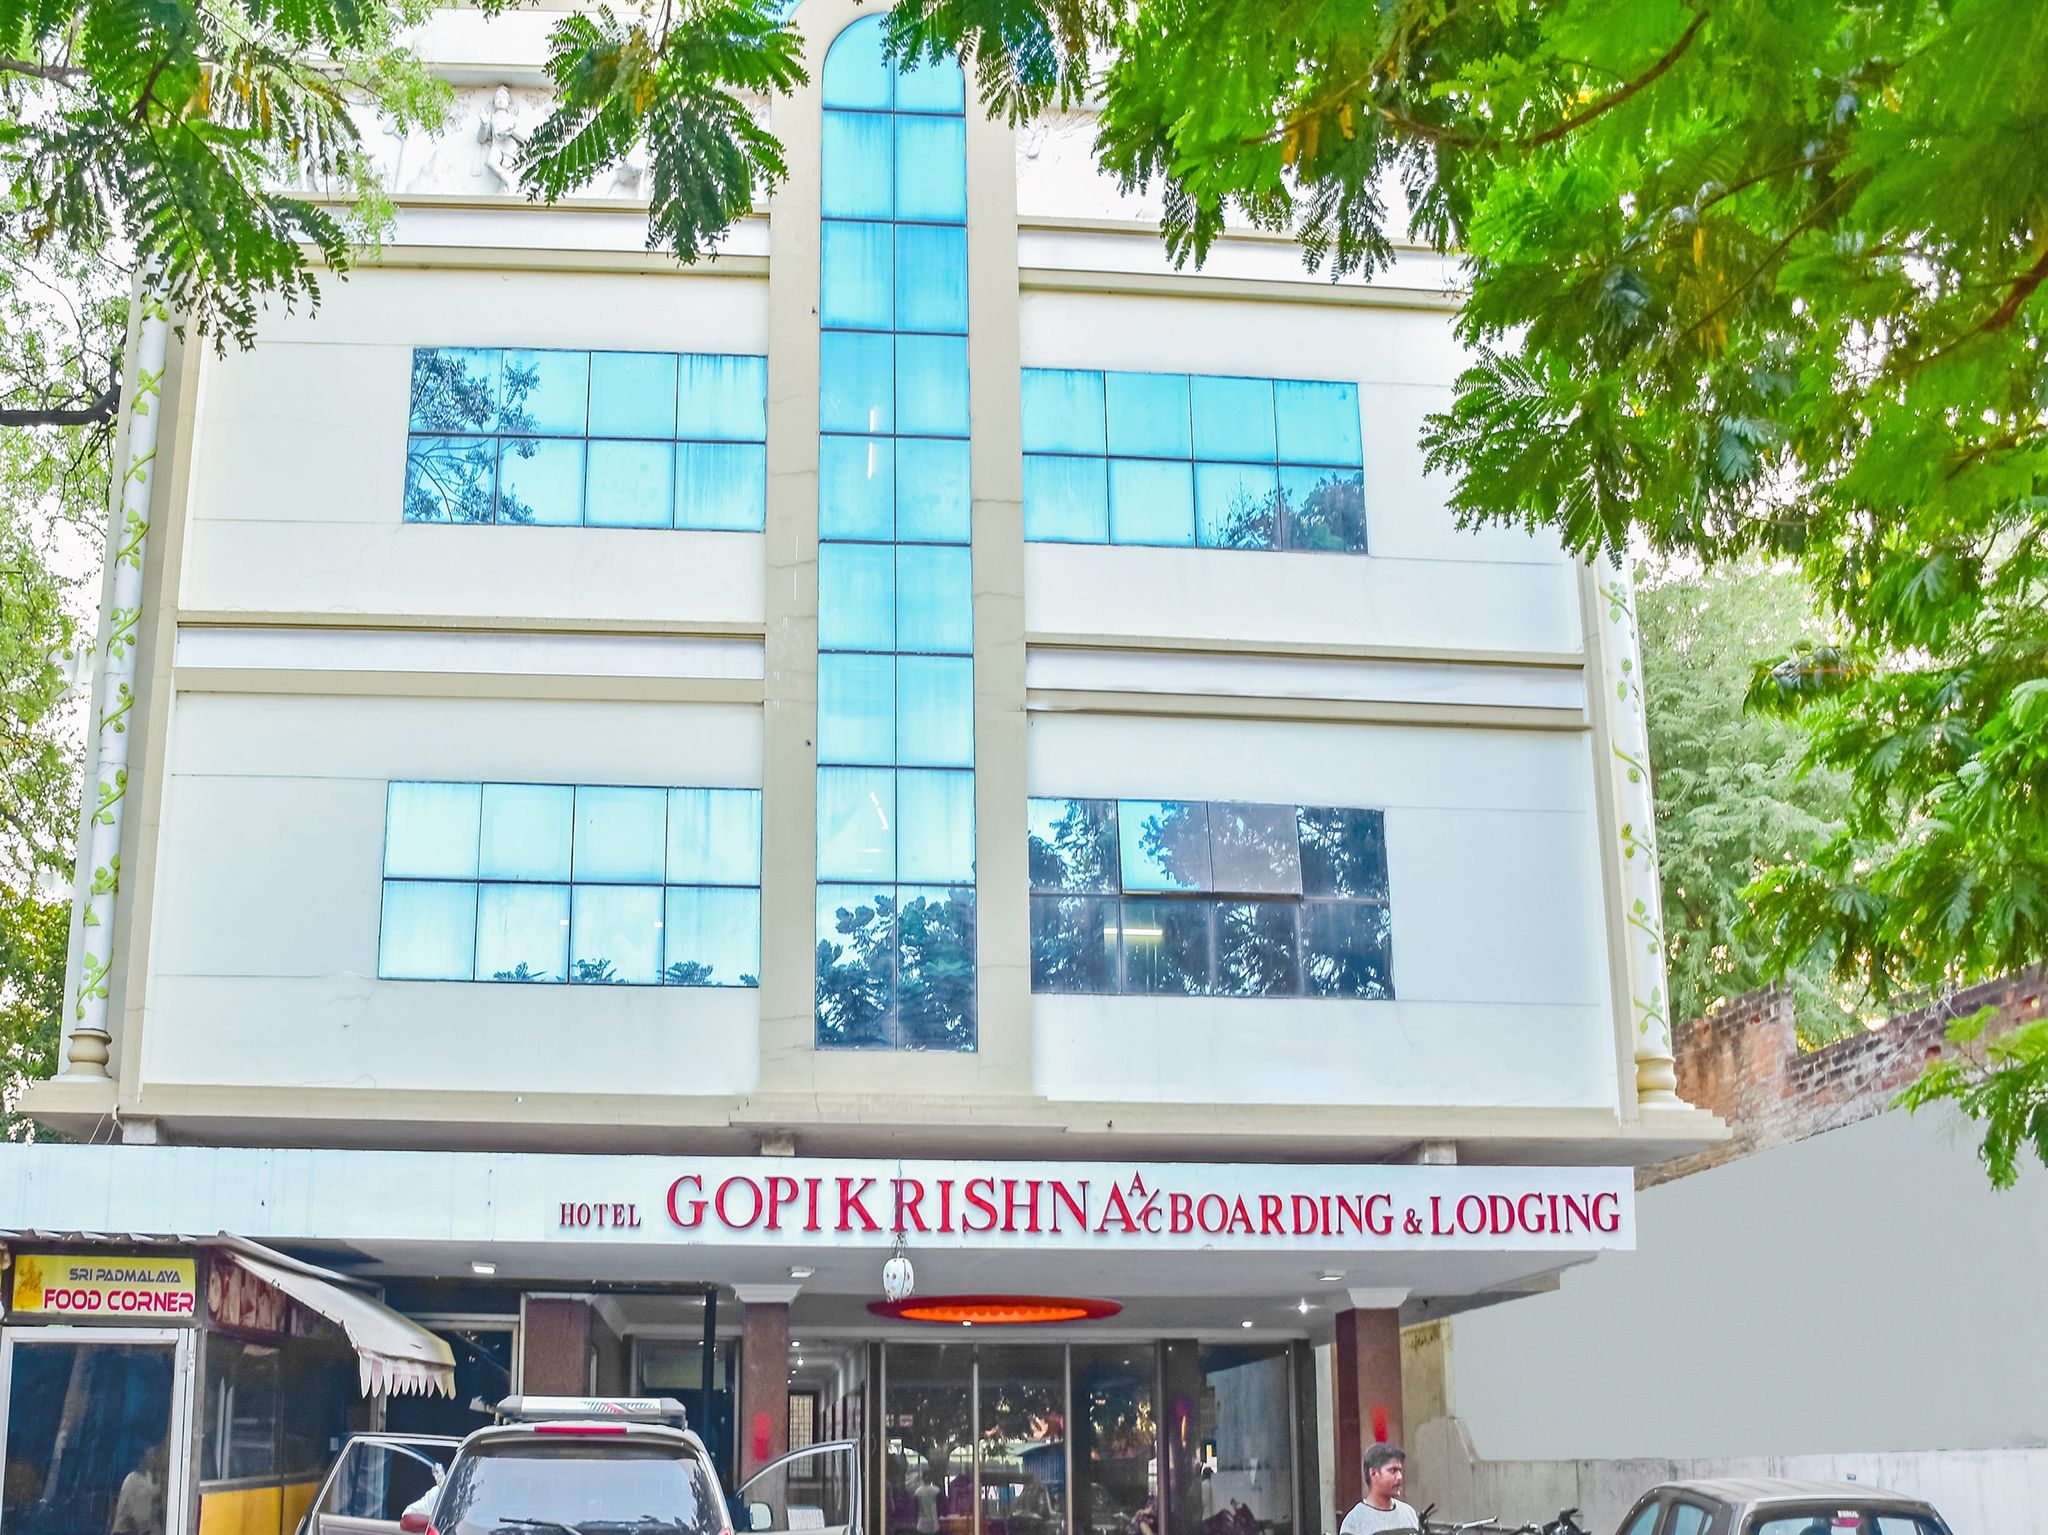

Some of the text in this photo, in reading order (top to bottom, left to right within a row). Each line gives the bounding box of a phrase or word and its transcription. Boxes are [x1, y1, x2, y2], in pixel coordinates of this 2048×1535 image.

[559, 1202, 642, 1228] HOTEL
[667, 1175, 1142, 1234] GOPIKRISHNA
[1169, 1193, 1394, 1238] BOARDING
[1404, 1208, 1424, 1235] &
[1430, 1192, 1621, 1237] LODGING
[69, 1268, 182, 1284] SRI PADMALAYA
[44, 1288, 195, 1313] FOOD CORNER
